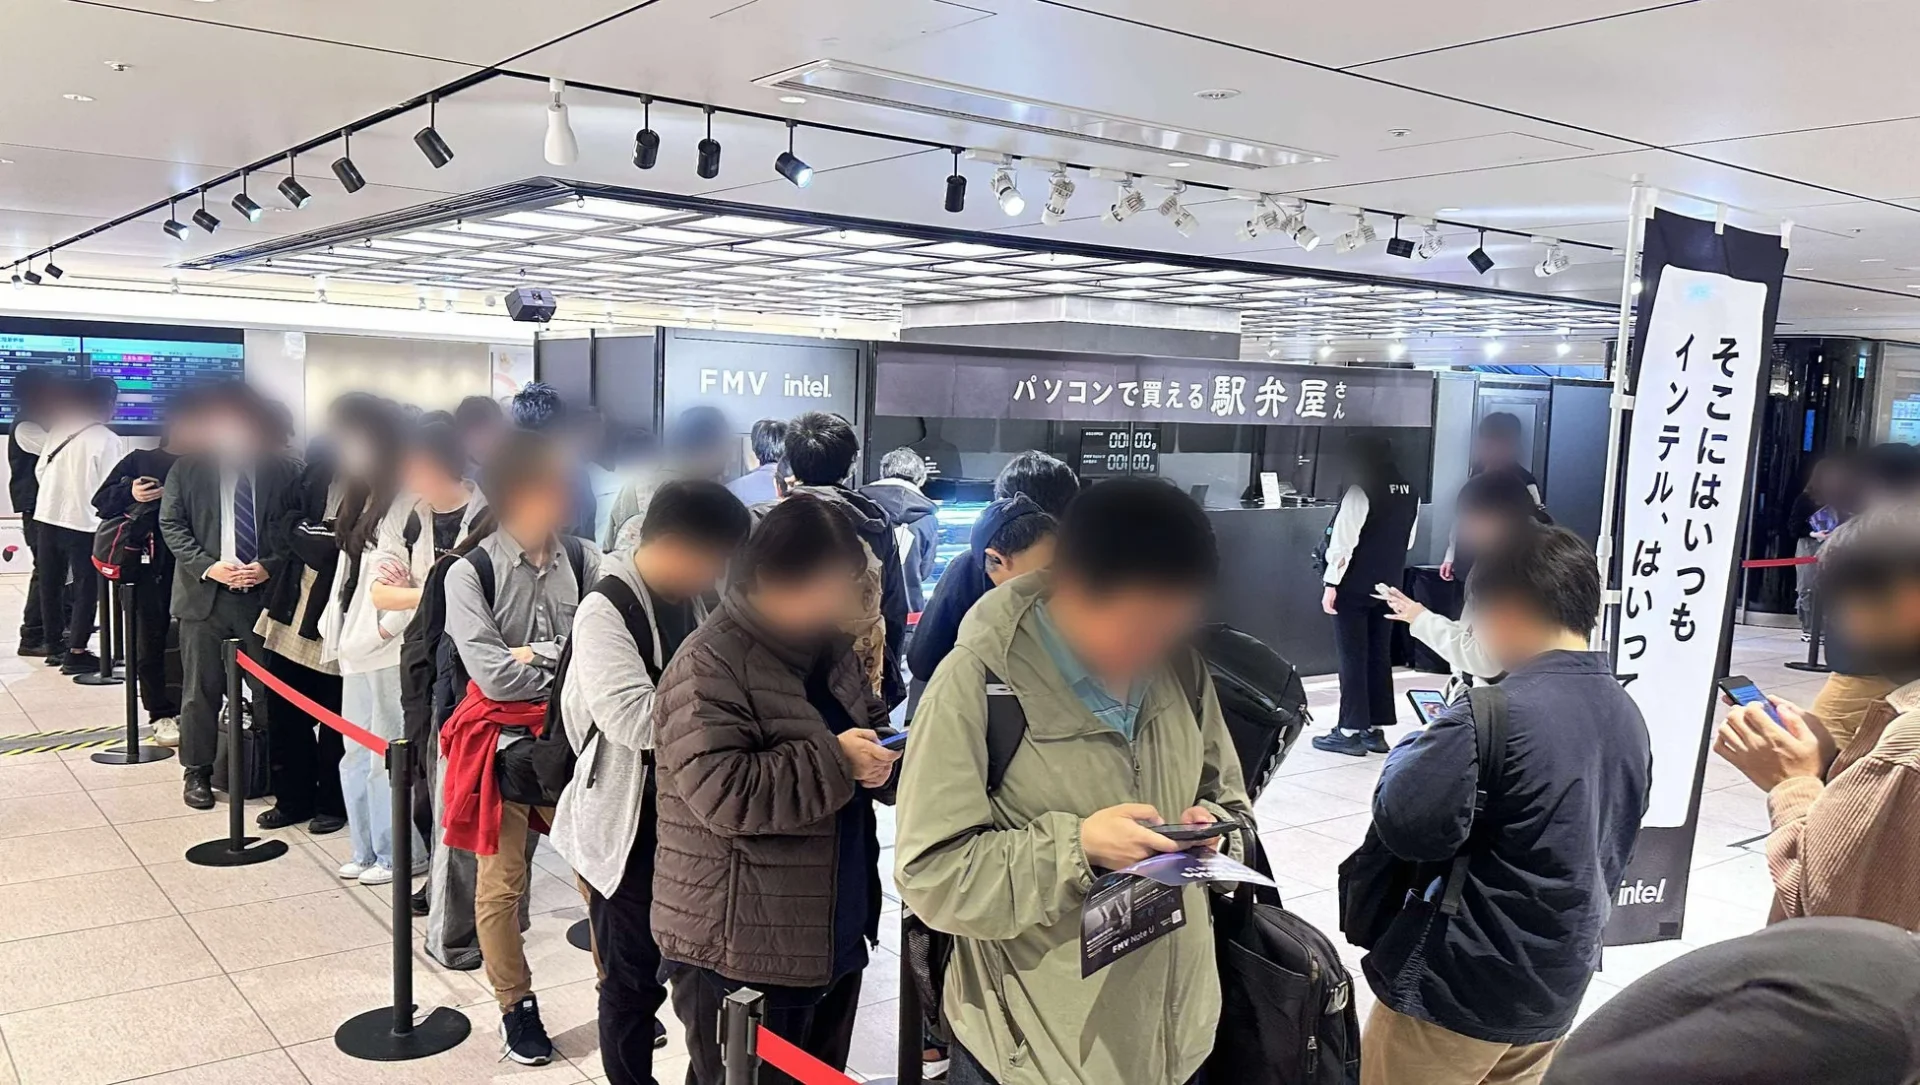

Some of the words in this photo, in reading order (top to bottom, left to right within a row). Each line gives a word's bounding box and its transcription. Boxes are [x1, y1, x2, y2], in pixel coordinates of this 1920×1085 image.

[700, 369, 768, 395] FMV
[1669, 337, 1740, 642] そこにはいつも
[1112, 938, 1129, 953] FMV
